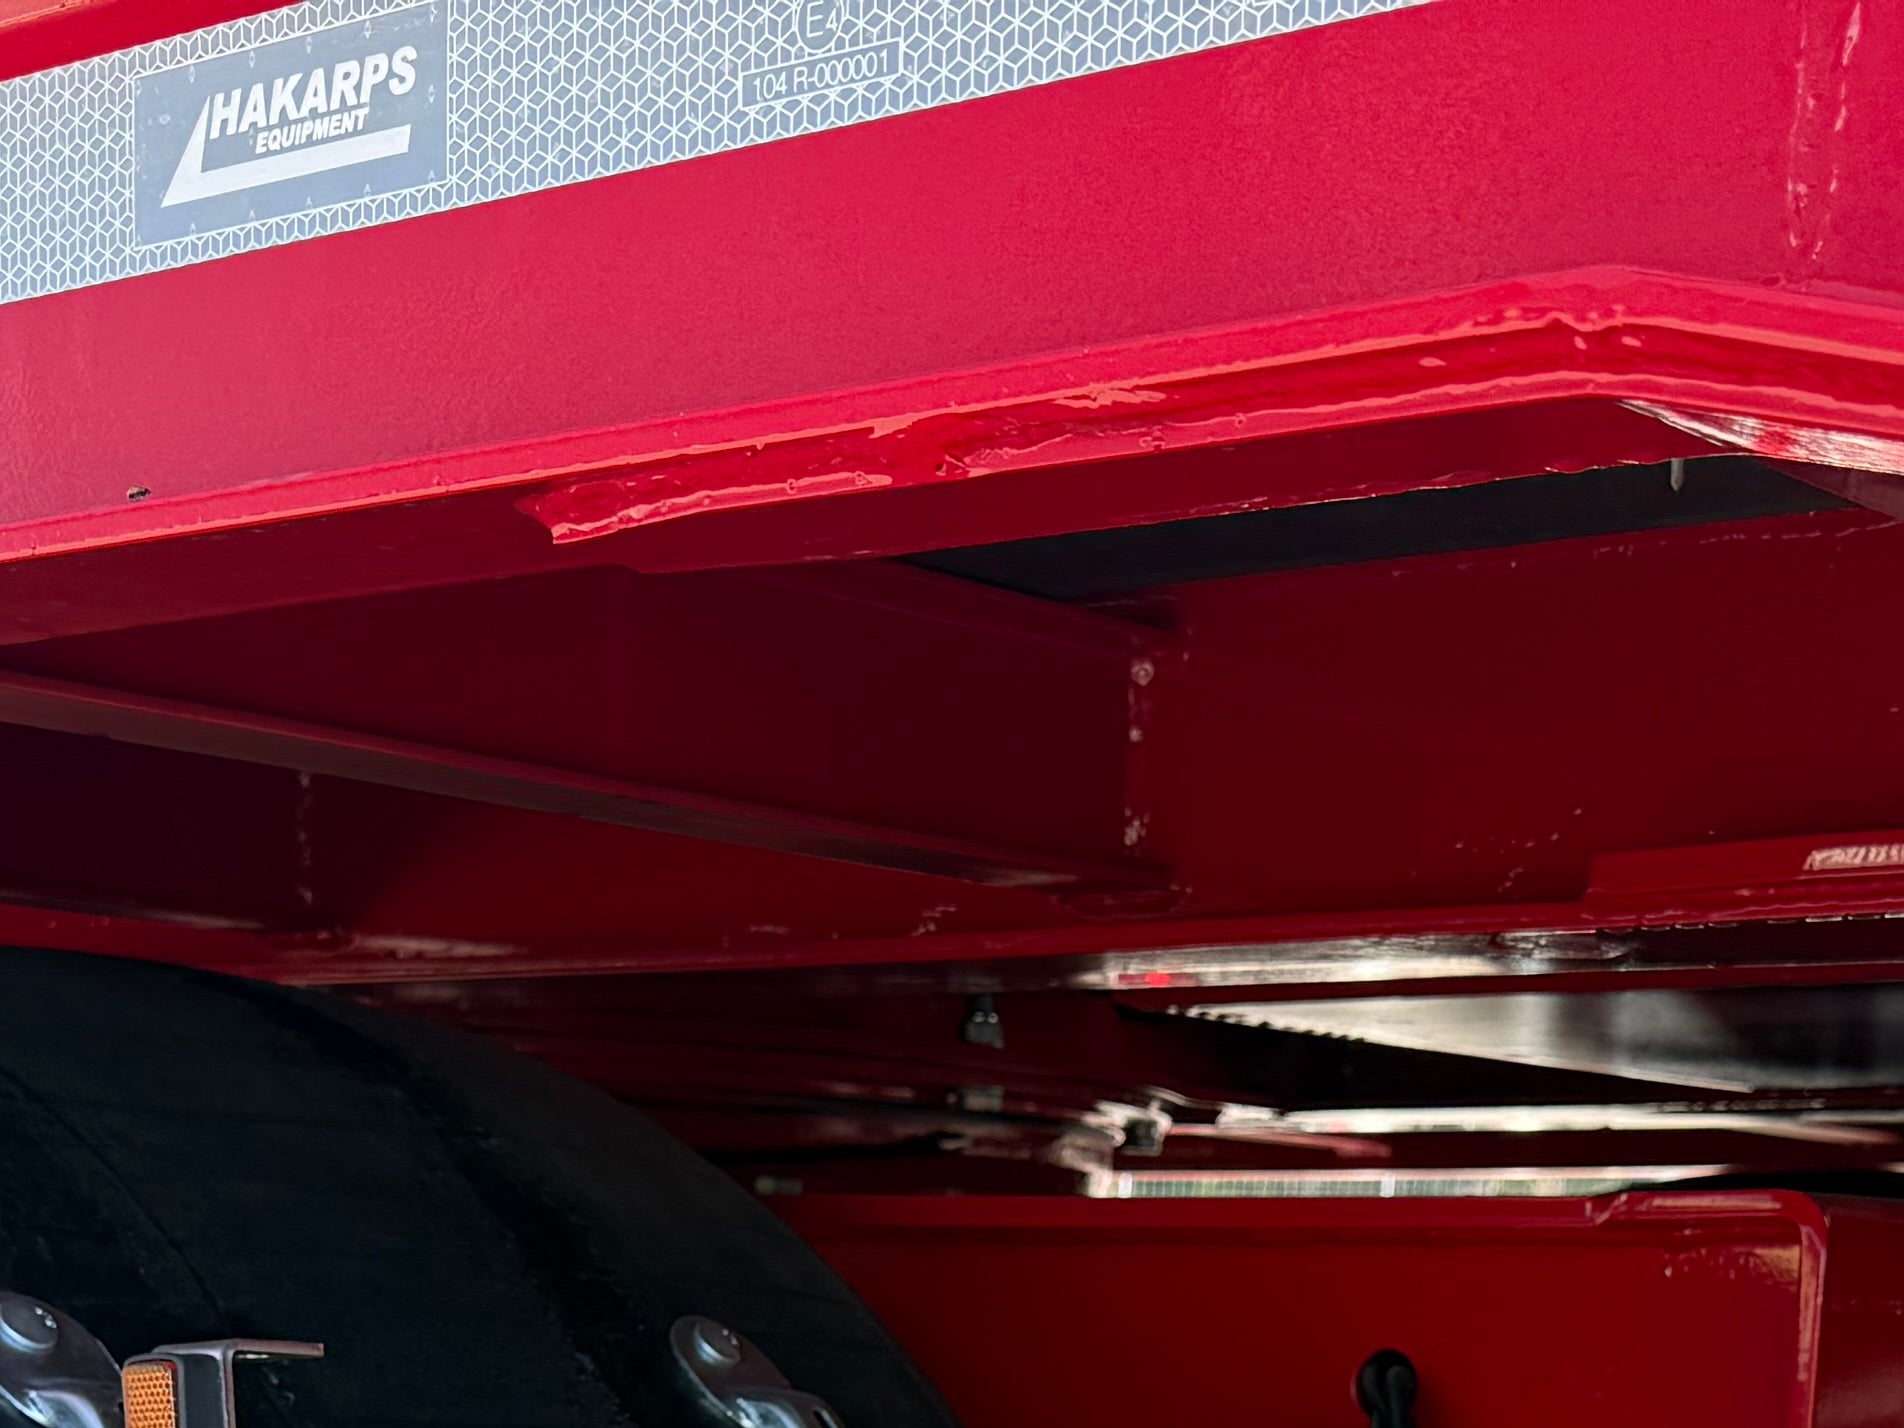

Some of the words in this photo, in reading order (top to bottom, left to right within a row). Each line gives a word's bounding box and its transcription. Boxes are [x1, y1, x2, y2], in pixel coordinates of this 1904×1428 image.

[209, 46, 418, 140] HAKARPS
[753, 72, 787, 101] 104
[255, 106, 370, 154] EQUIPMENT
